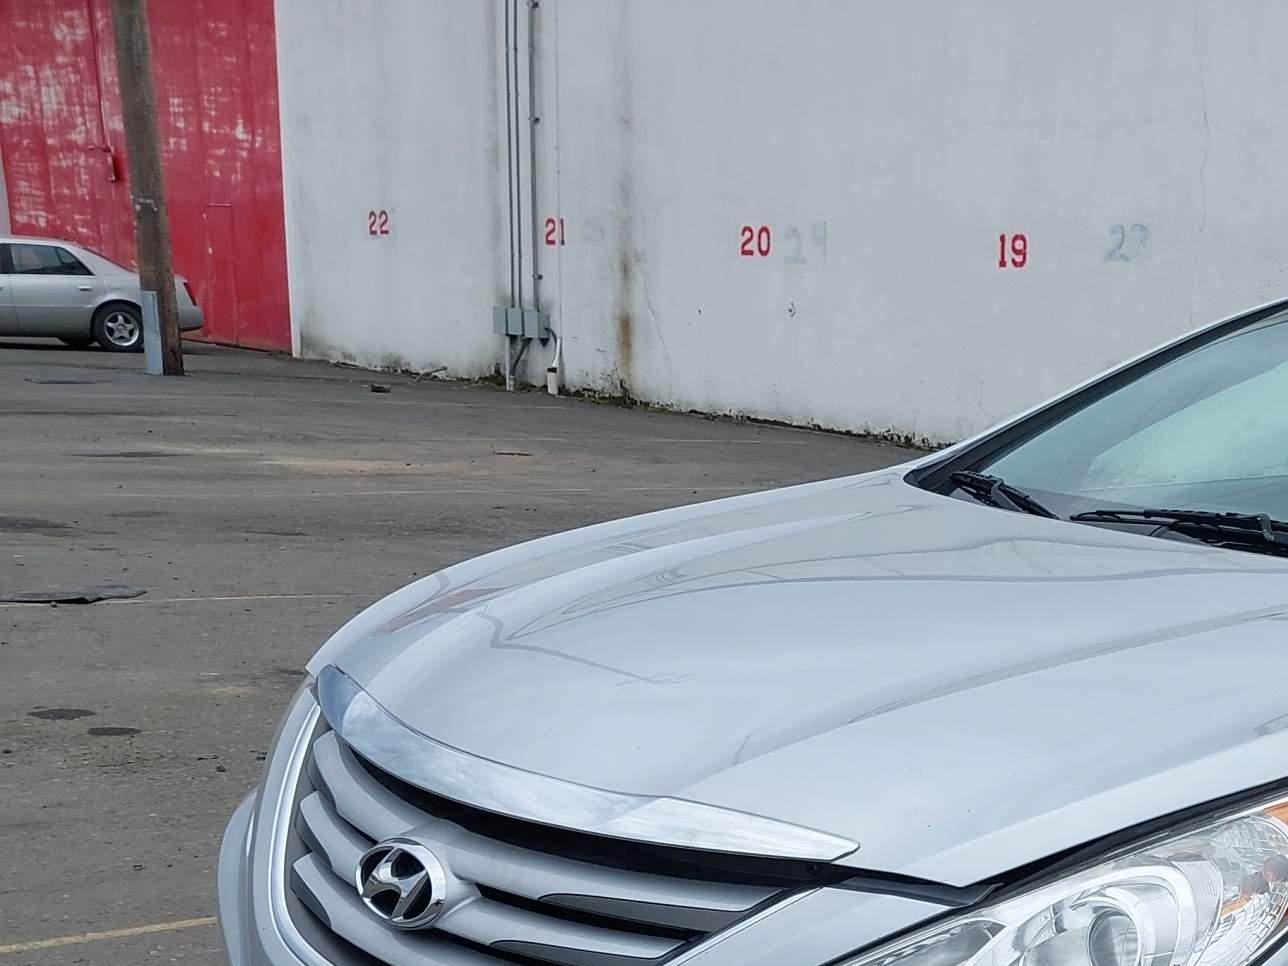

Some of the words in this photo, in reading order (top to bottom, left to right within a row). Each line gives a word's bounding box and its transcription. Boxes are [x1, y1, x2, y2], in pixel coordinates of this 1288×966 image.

[369, 210, 390, 235] 22
[545, 218, 566, 246] 21
[741, 226, 771, 257] 20
[999, 233, 1028, 269] 19
